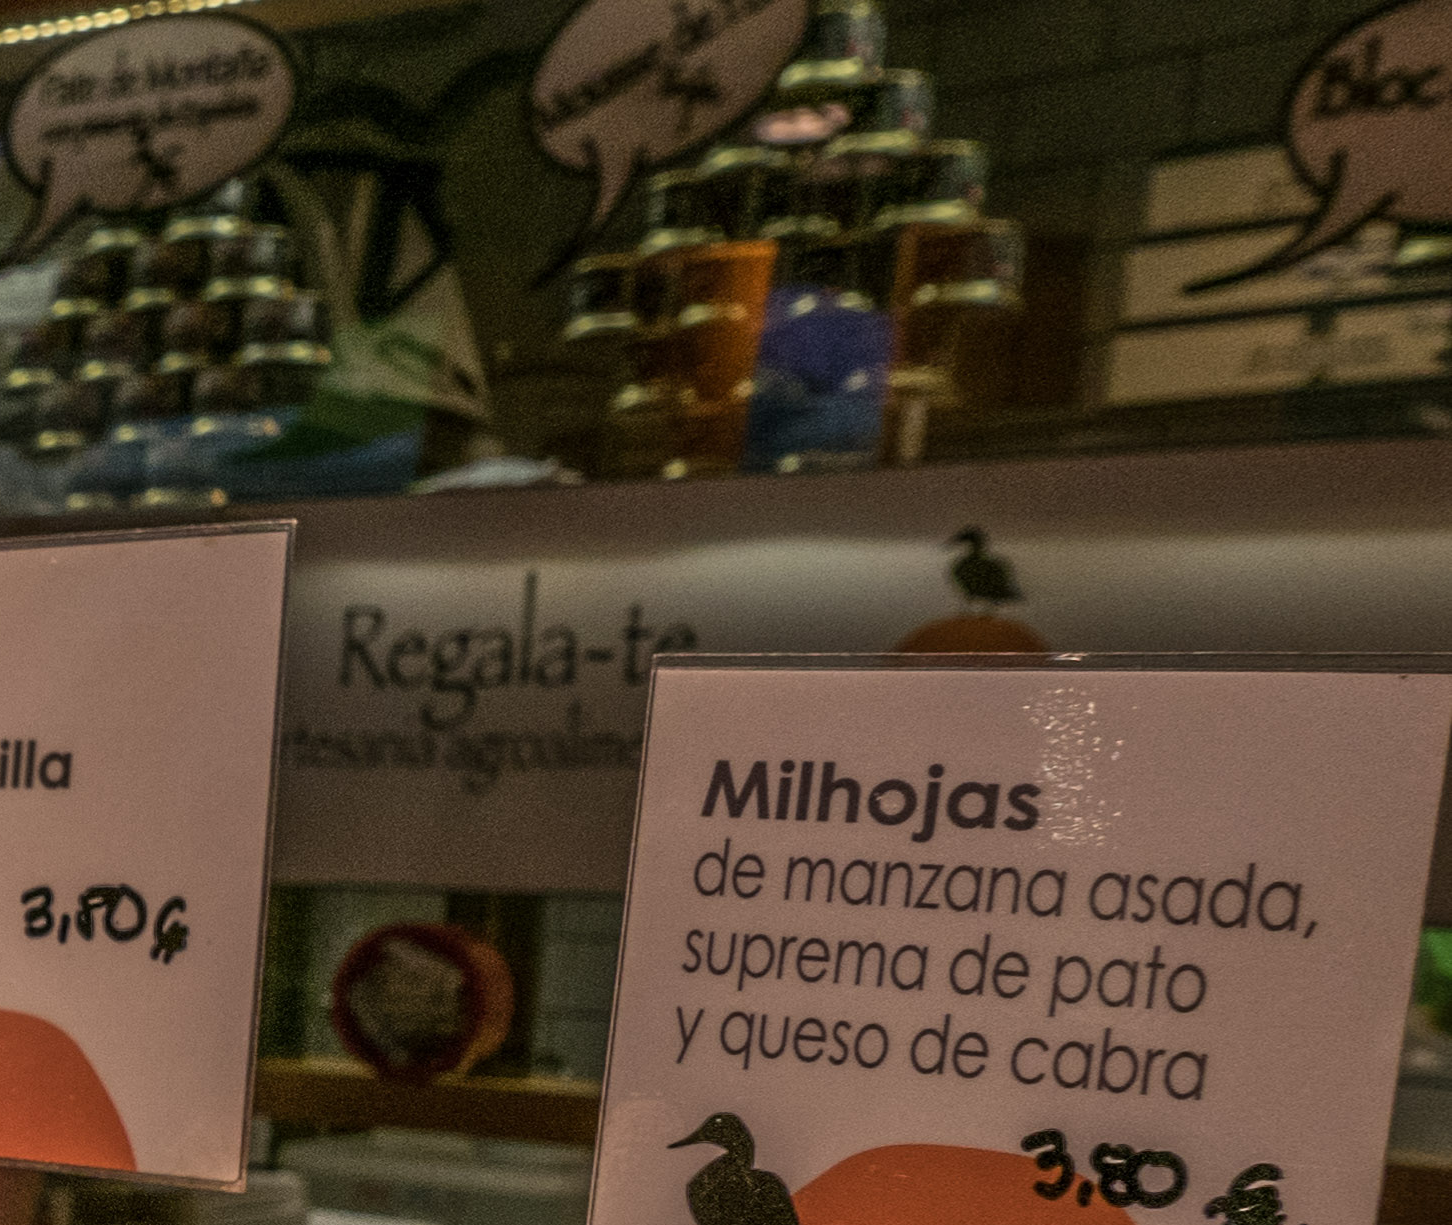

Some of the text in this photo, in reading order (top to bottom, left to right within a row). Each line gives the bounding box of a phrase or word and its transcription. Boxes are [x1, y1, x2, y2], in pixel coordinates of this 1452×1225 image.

[701, 759, 1042, 843] Milhojas
[693, 839, 1320, 939] de manzana asada,
[681, 927, 1208, 1017] suprema de pato
[674, 1005, 1209, 1102] y queso de cabra
